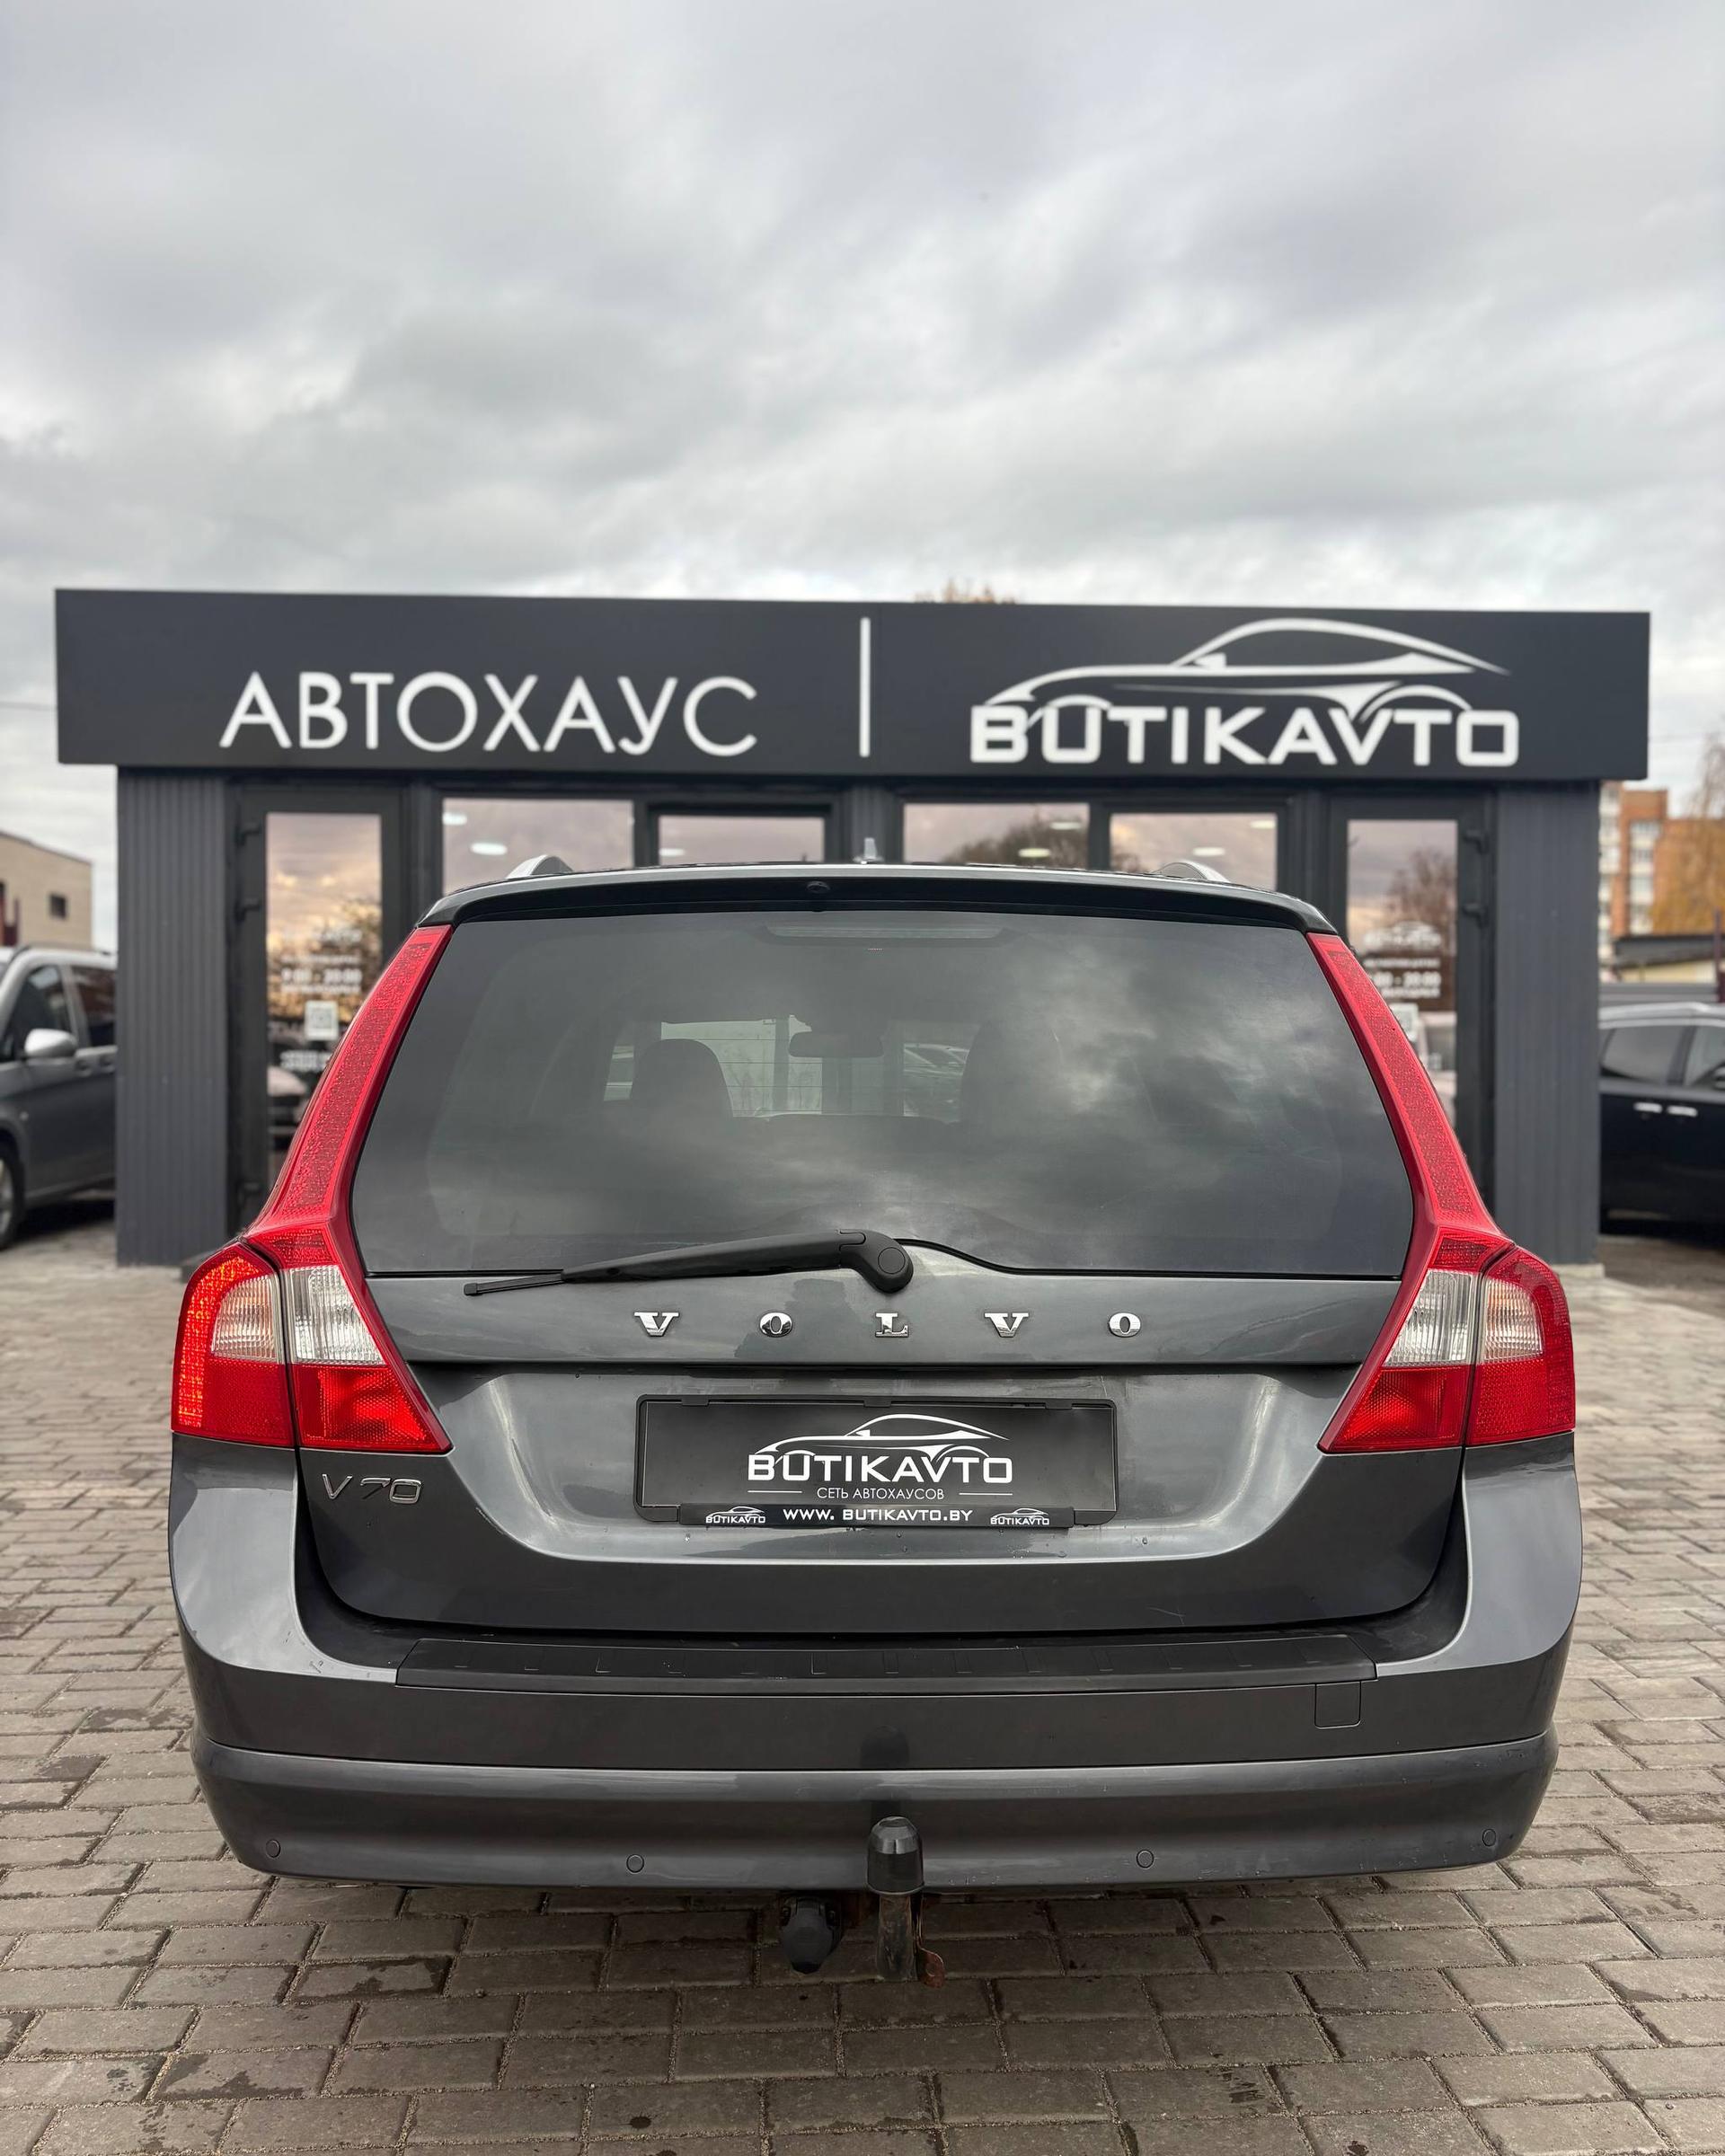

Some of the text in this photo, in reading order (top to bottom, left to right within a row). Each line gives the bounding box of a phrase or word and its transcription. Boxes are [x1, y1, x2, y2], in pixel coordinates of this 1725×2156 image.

[219, 671, 758, 756] АВТОХАУС
[970, 705, 1518, 767] BUTIKAVTO
[633, 1312, 1142, 1338] VOLVO
[748, 1454, 1013, 1483] BUTIKAVTO
[817, 1487, 944, 1500] СЕТЬ АВТОХАУСОВ
[705, 1515, 766, 1524] BUTIKAVTO
[783, 1508, 973, 1522] WWW. BUTIKAVTO.BY
[990, 1517, 1050, 1525] BUTIKAVTO
